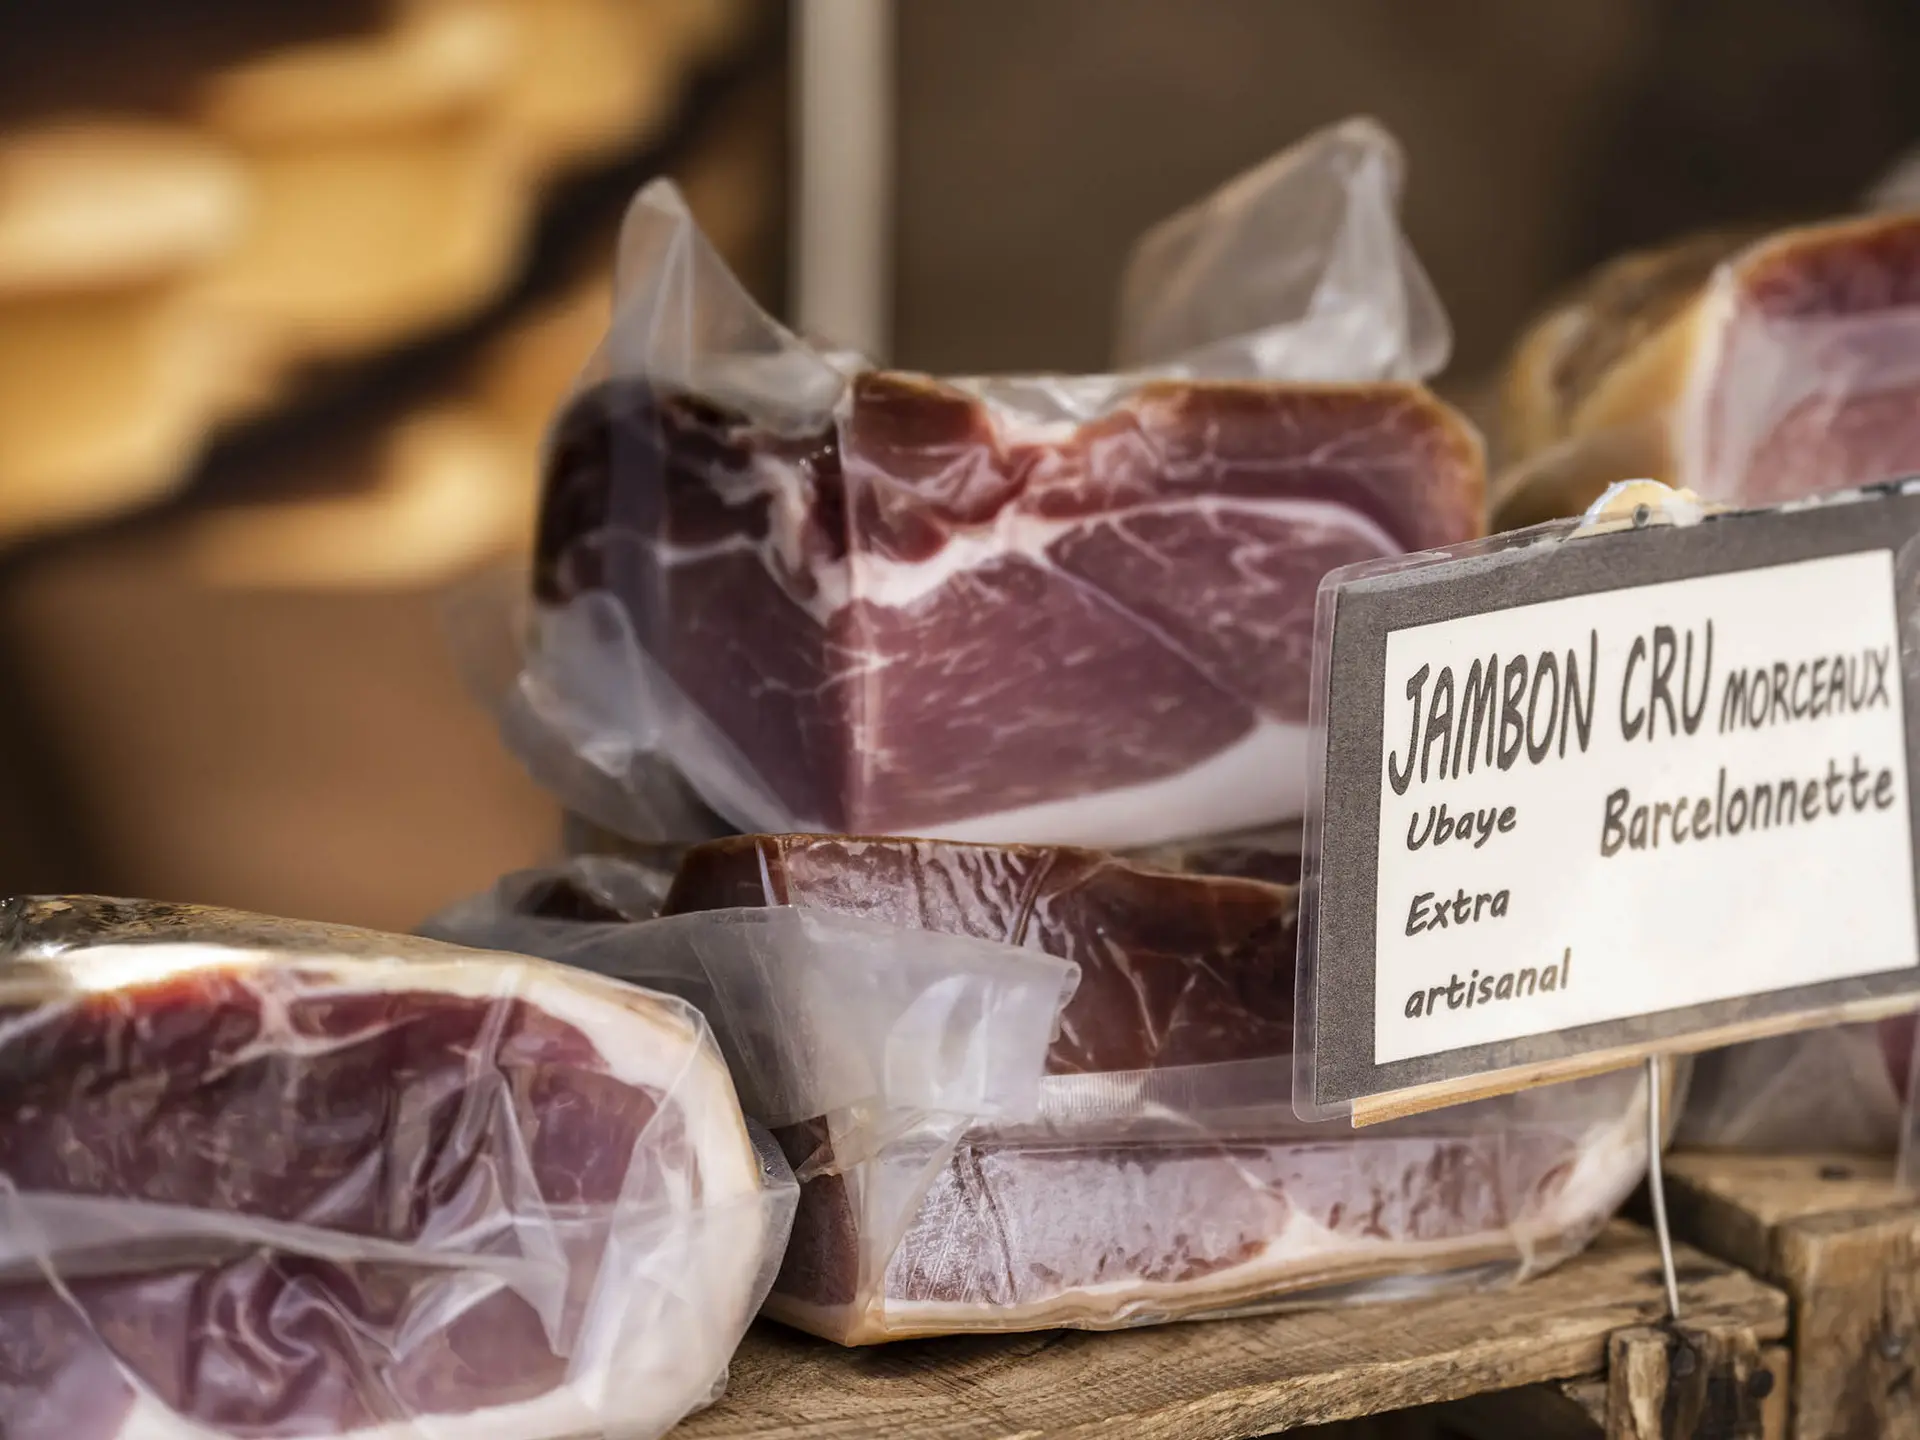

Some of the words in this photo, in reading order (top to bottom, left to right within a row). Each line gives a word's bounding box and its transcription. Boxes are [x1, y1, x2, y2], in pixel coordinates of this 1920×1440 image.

[1388, 628, 1598, 796] JAMBON
[1619, 618, 1714, 742] CRU
[1719, 647, 1890, 734] MORCEAUX
[1406, 803, 1517, 852] Ubaye
[1600, 756, 1895, 858] Barcelonnette
[1404, 888, 1510, 937] Extra
[1404, 948, 1571, 1019] artisanal
